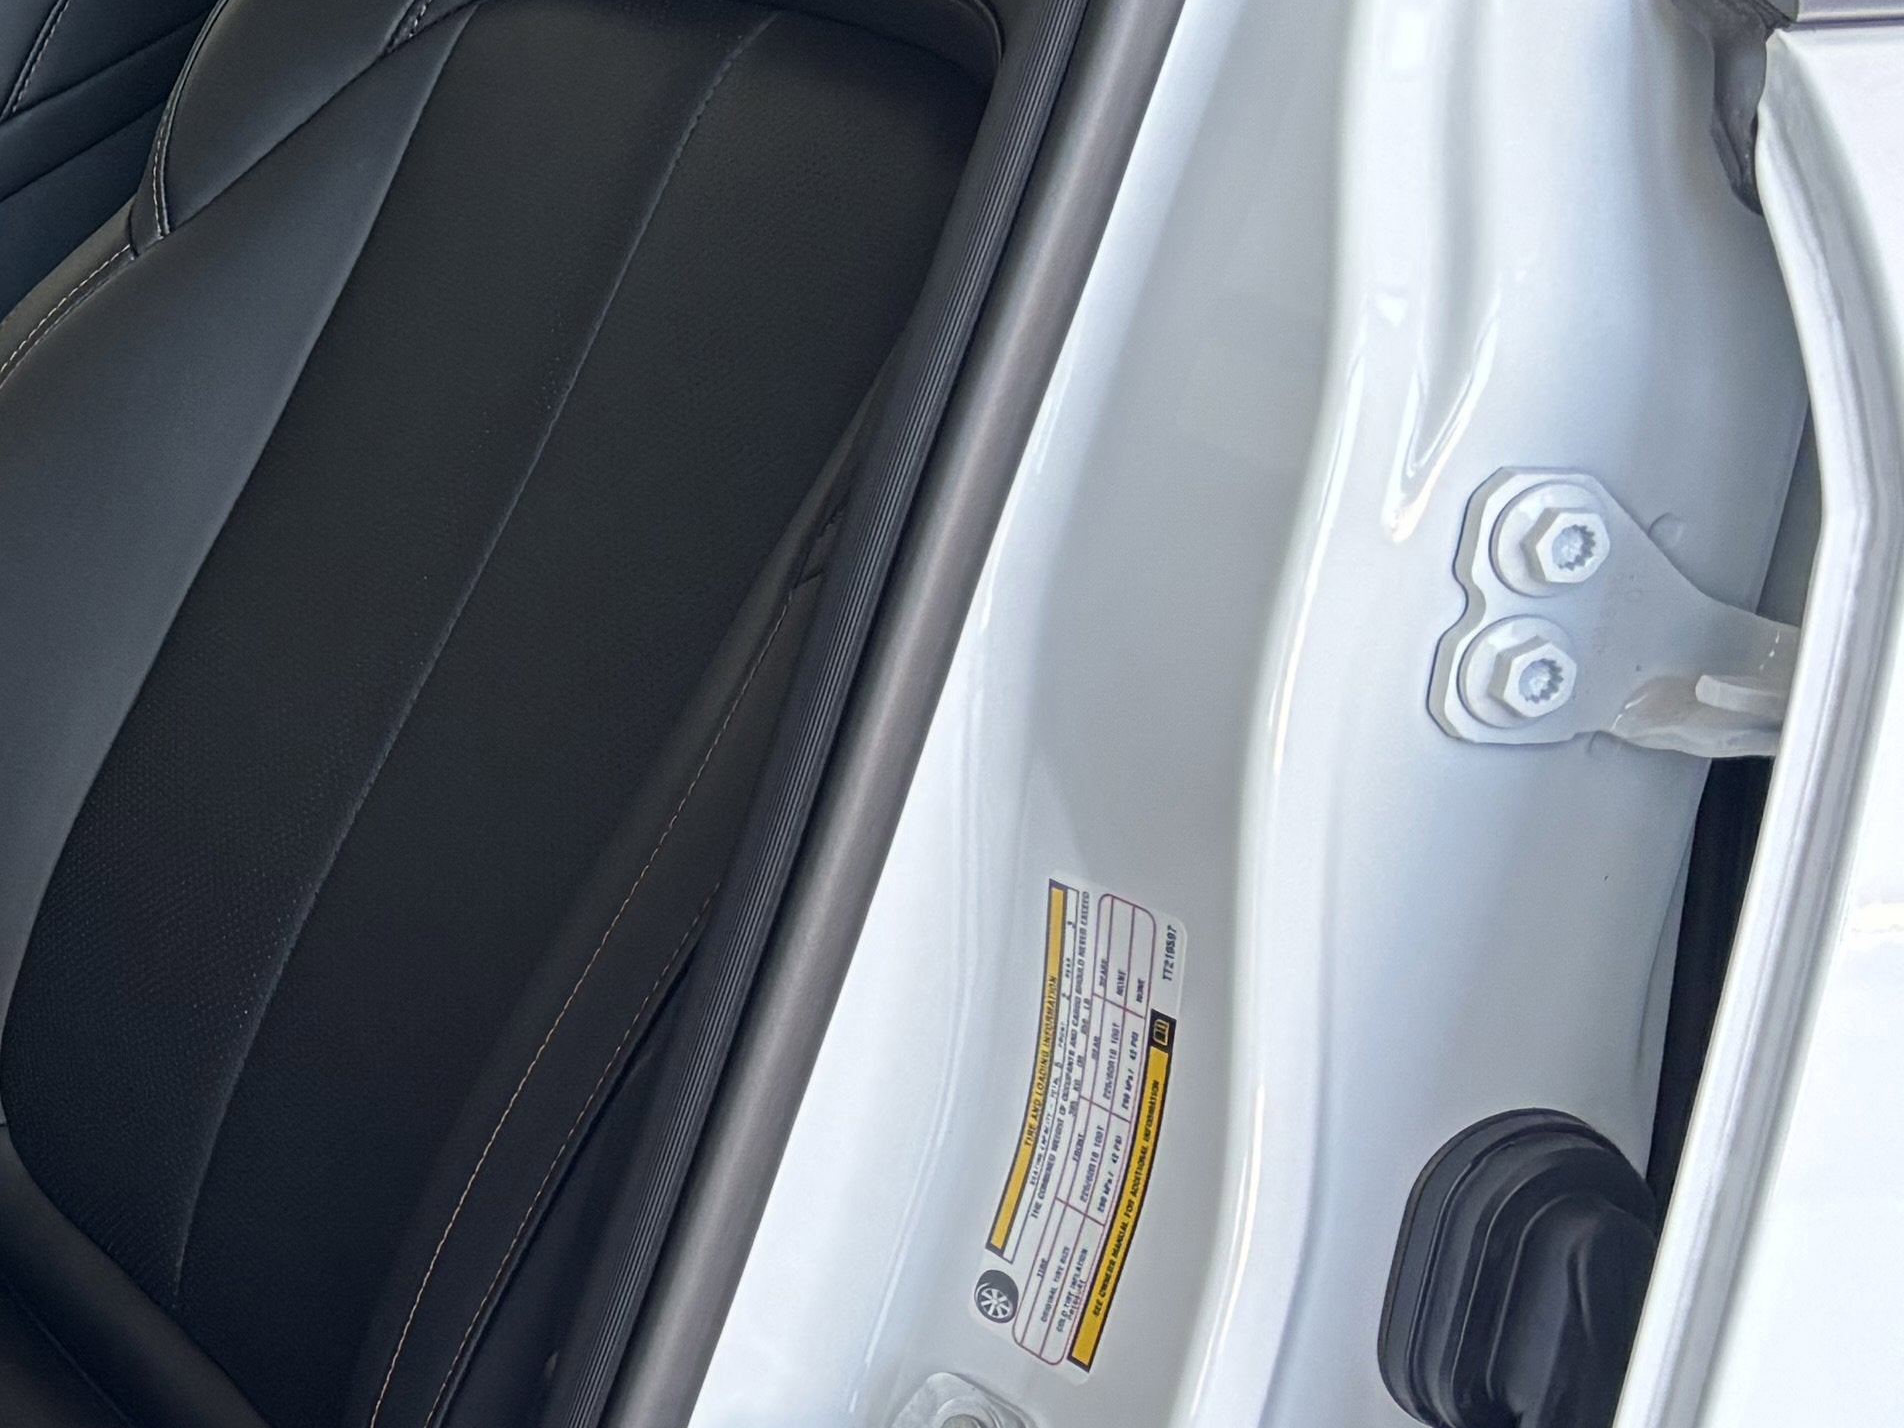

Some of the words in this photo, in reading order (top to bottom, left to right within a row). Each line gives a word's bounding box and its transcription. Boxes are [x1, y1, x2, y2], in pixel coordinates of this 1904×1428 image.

[1041, 975, 1057, 1046] INFORMATION
[1034, 1050, 1049, 1095] LOADING
[1029, 1097, 1041, 1120] AND
